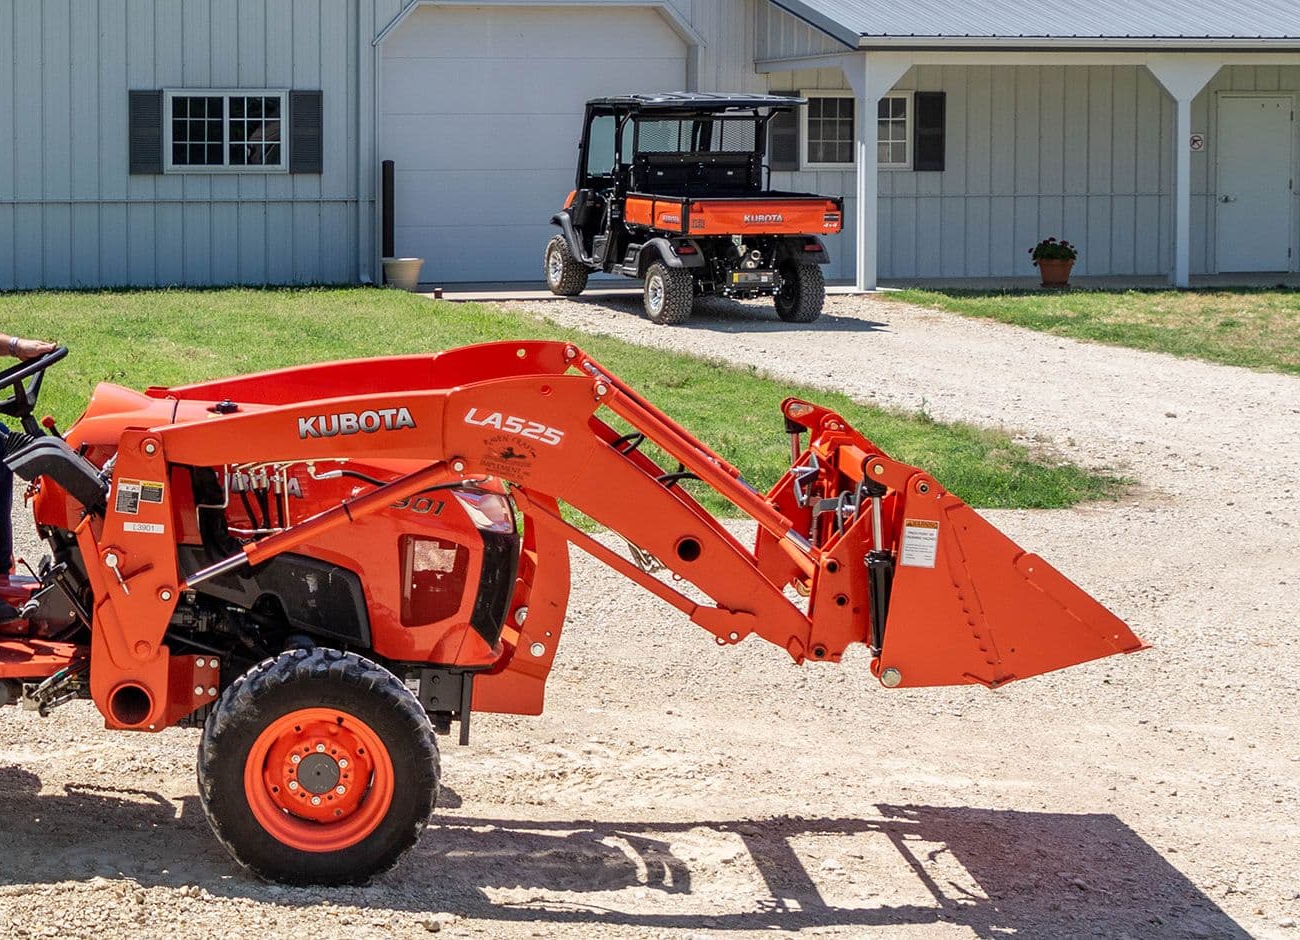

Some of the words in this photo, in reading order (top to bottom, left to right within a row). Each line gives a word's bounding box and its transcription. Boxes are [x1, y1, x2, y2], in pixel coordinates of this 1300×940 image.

[743, 214, 784, 223] KUBOTA
[298, 407, 417, 439] KUBOTA
[464, 407, 565, 446] LA525
[133, 523, 154, 531] L3901
